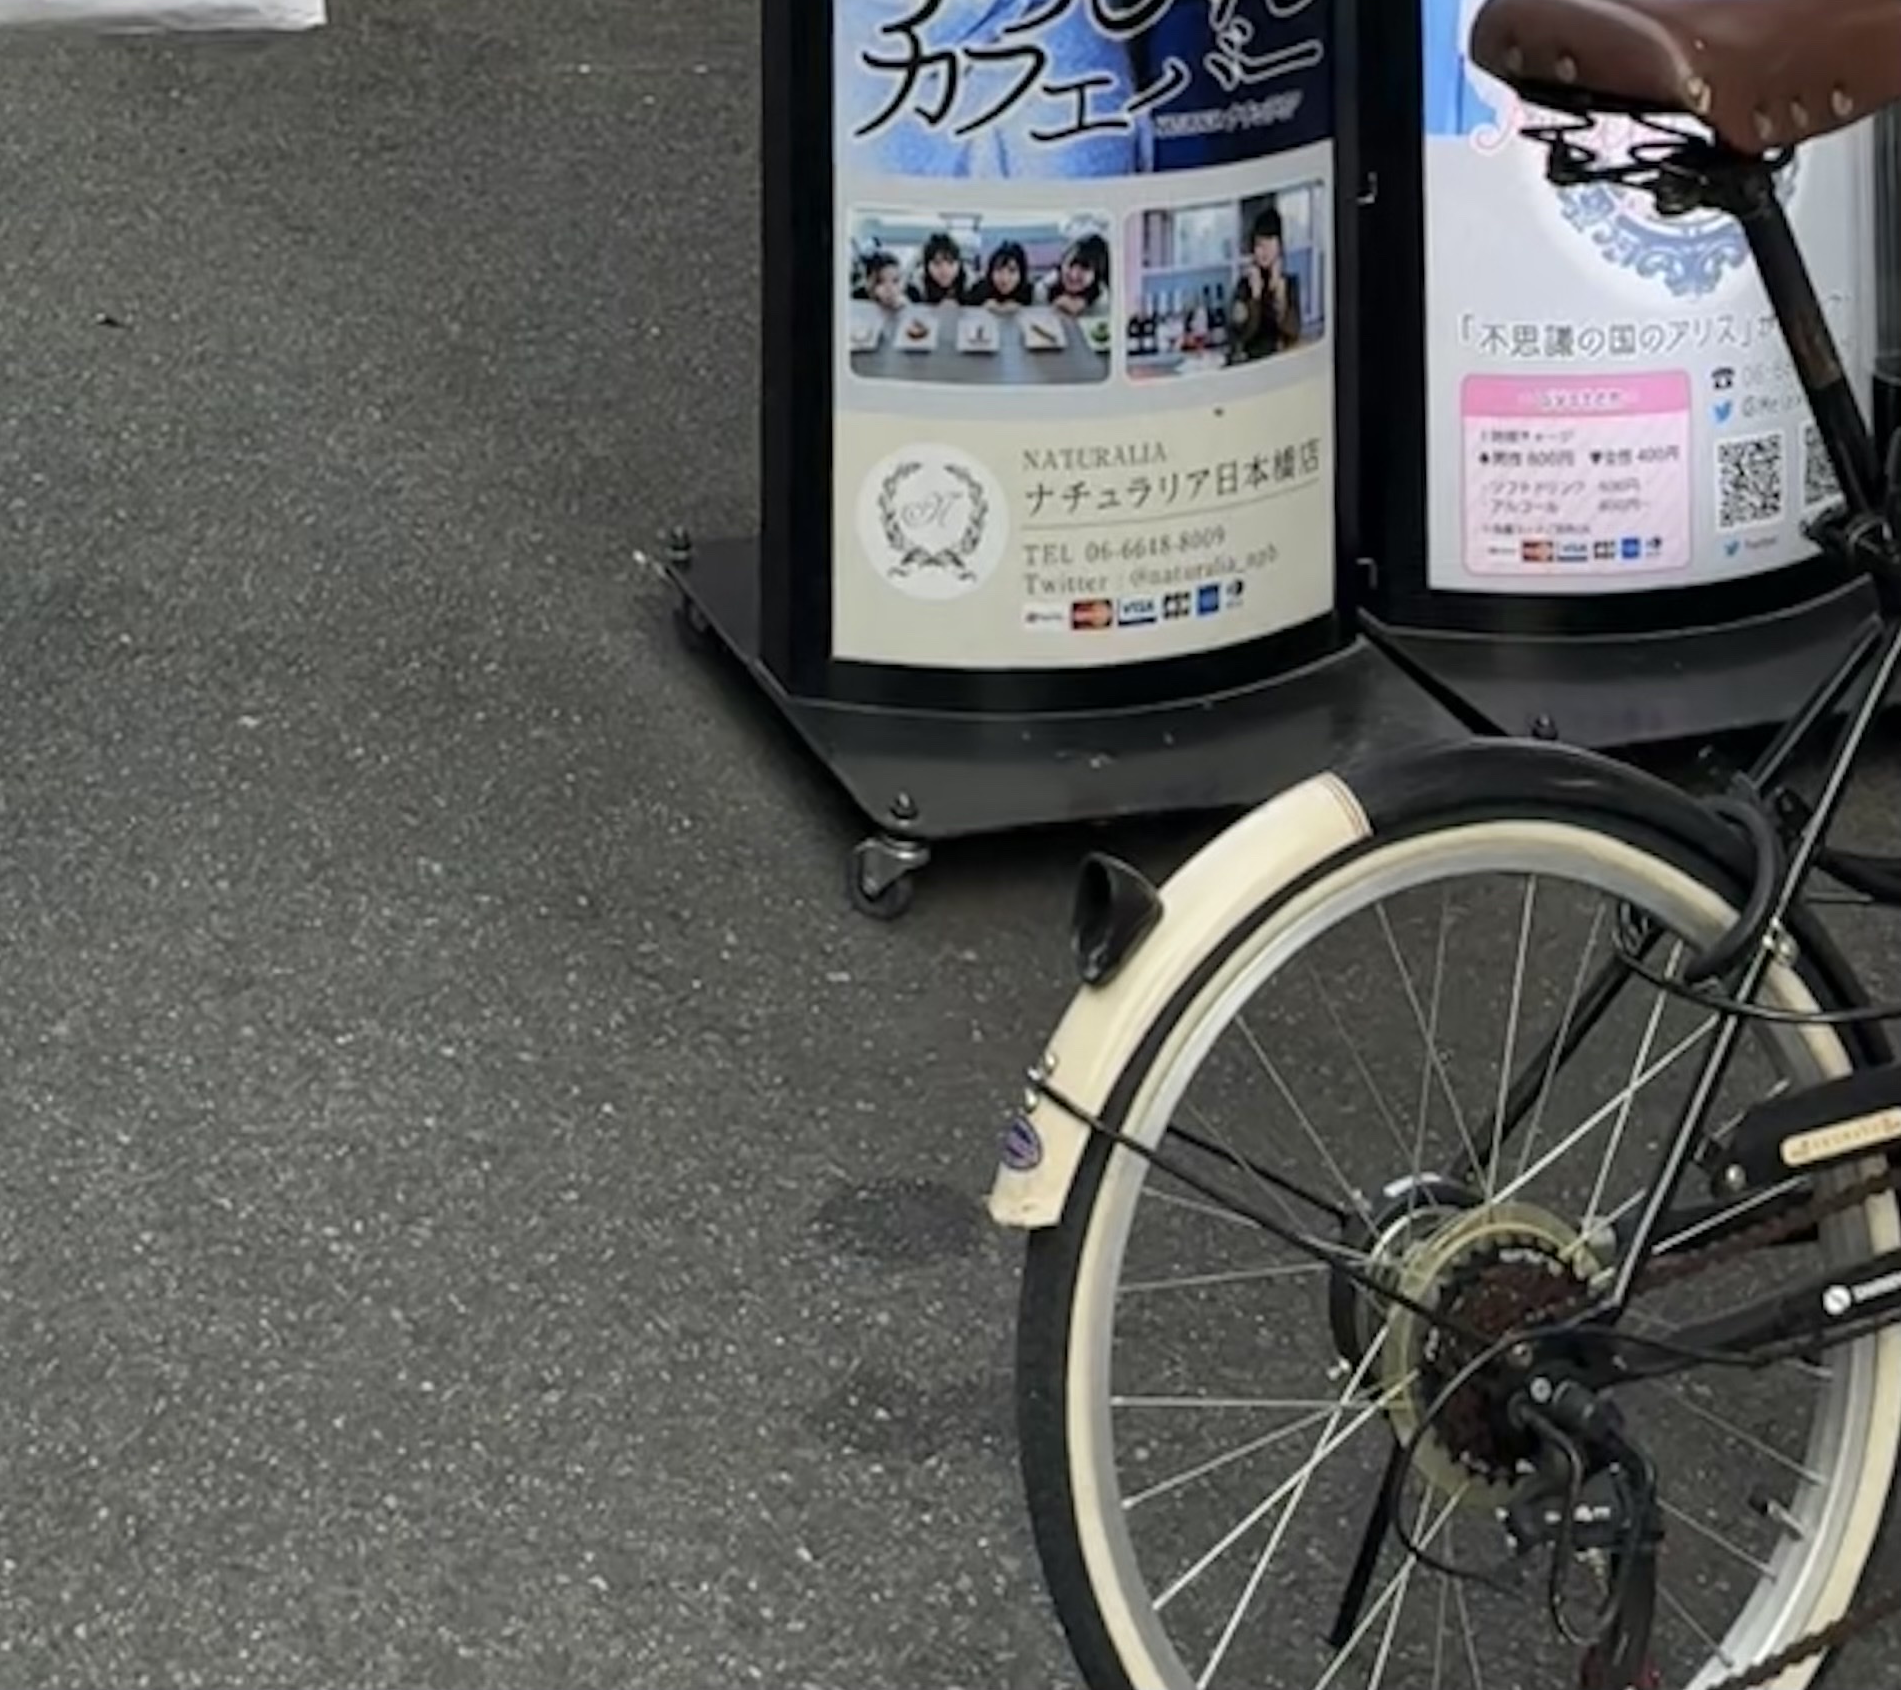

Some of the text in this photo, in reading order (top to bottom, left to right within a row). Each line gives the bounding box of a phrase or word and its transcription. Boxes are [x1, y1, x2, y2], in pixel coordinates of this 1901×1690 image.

[1022, 441, 1167, 472] NATURALIA
[1024, 437, 1322, 517] ナチュラリア日本橋店
[1024, 544, 1074, 566] TEL
